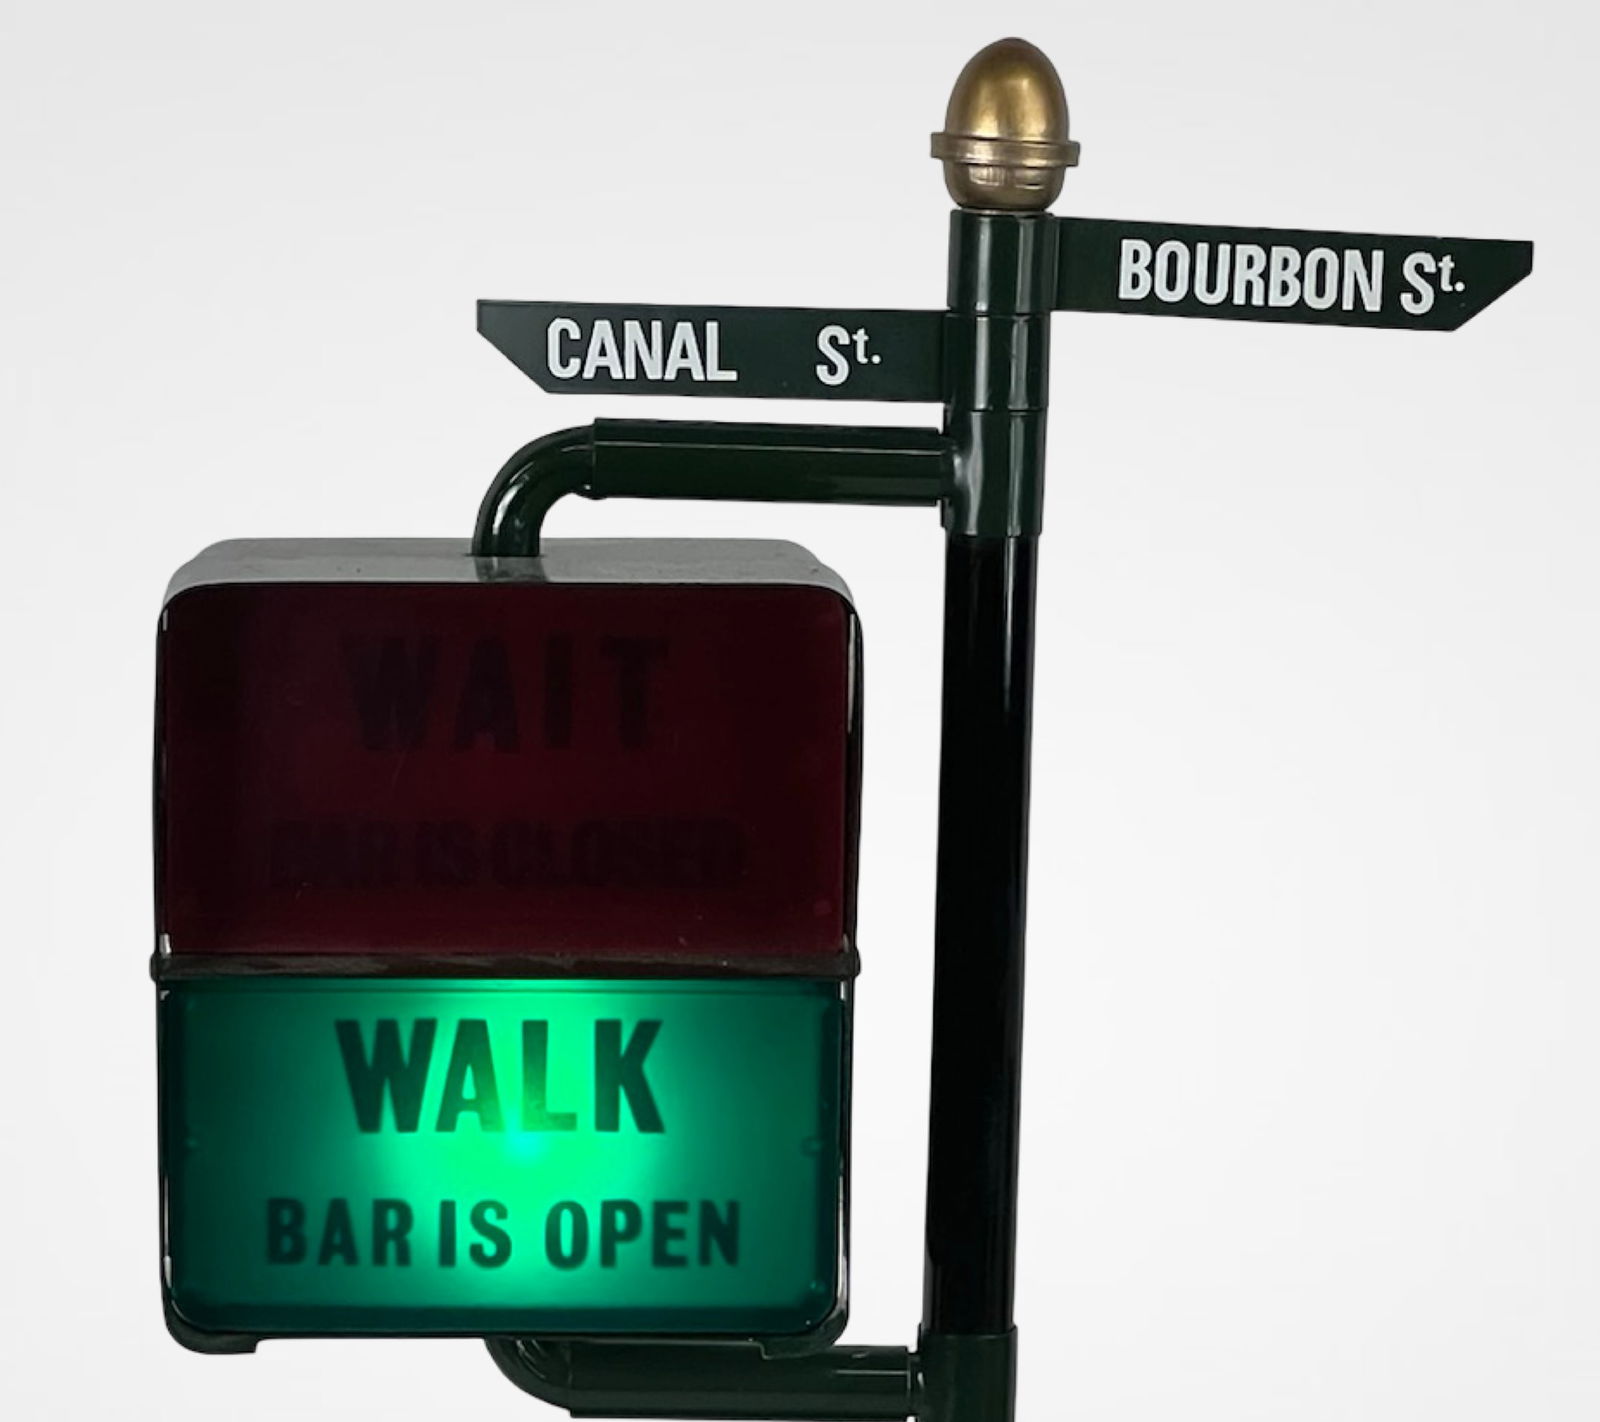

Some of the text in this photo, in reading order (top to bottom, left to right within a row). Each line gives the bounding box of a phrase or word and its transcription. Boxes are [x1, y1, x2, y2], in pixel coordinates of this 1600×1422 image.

[1118, 238, 1466, 315] BOURBON St.
[547, 317, 882, 386] CANAL St.
[340, 632, 673, 753] WAIT
[334, 1018, 666, 1134] WALK
[265, 1198, 742, 1271] BAR IS OPEN
